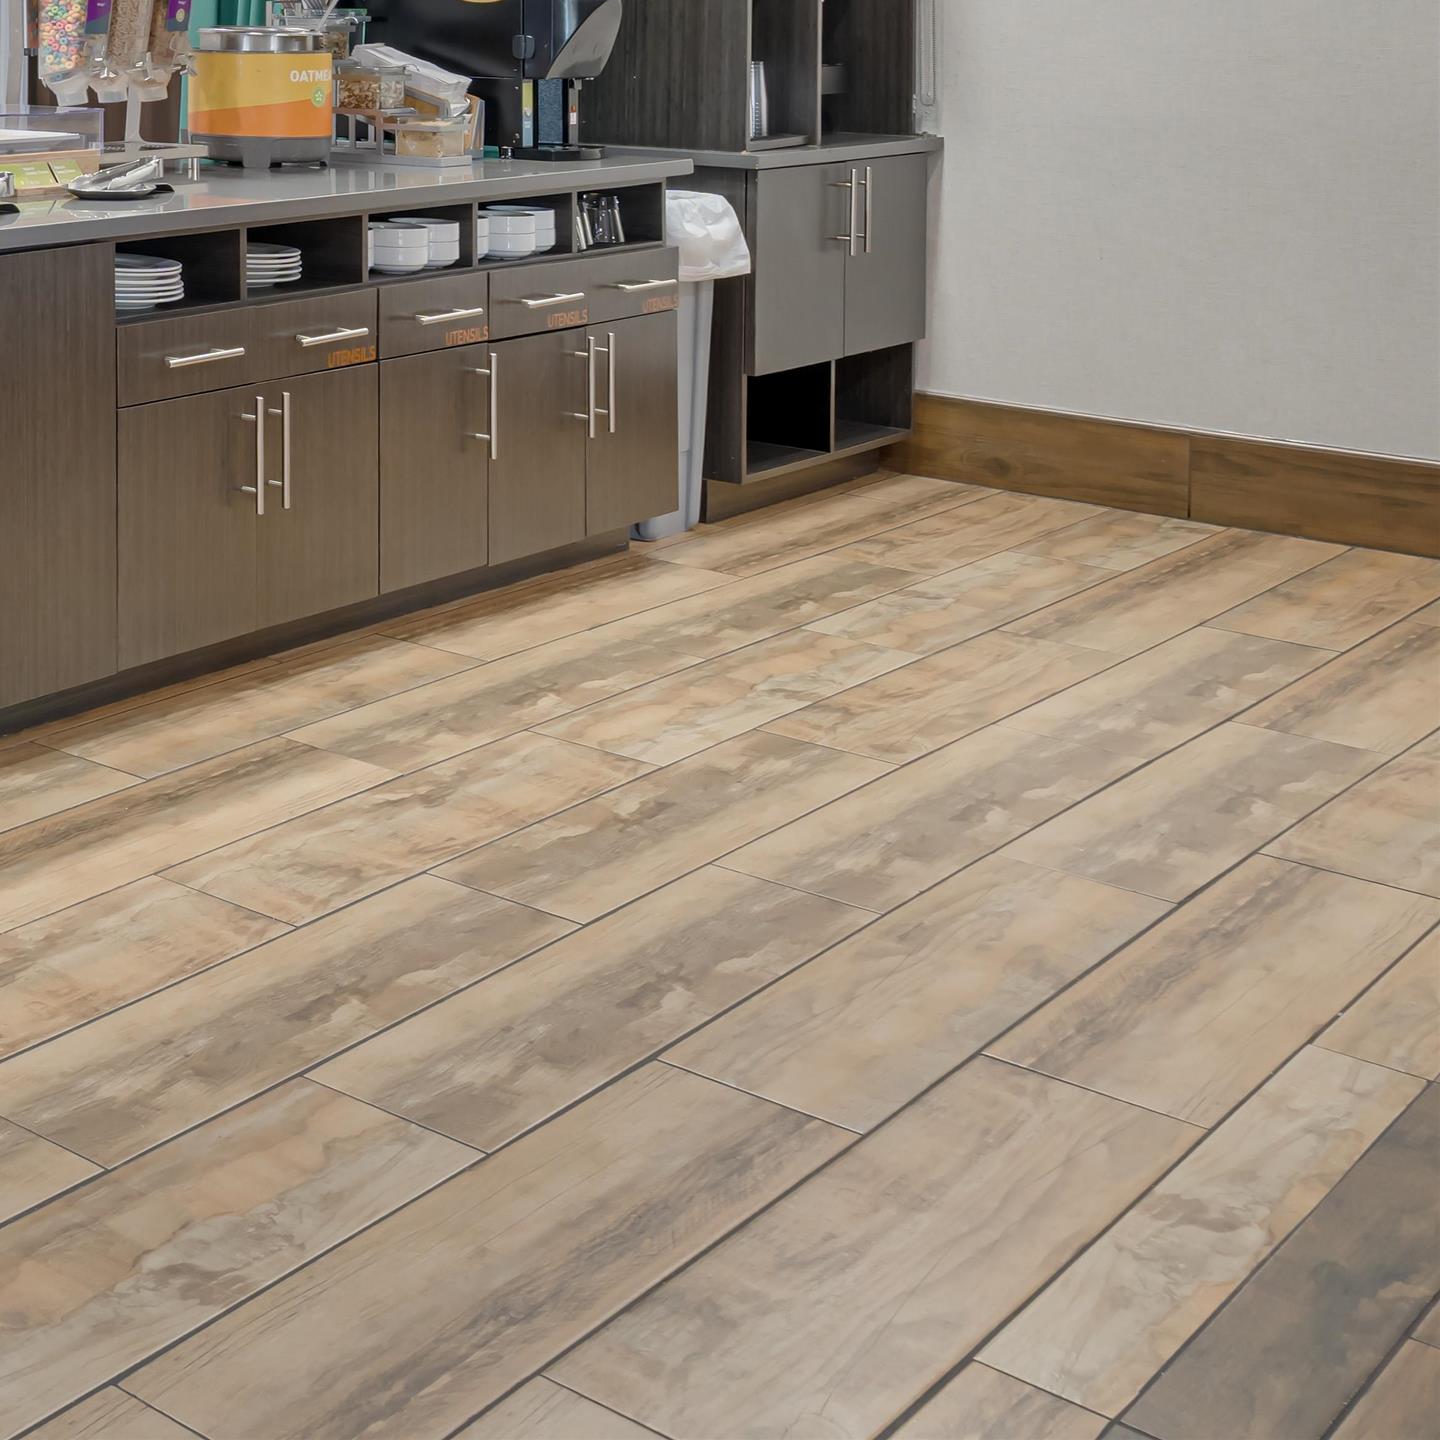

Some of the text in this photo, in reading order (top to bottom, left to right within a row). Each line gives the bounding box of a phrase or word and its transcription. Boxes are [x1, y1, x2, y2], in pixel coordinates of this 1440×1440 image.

[642, 295, 680, 314] UTENSILS
[547, 308, 589, 328] UTENSILS
[445, 324, 489, 346] UTENSILS
[327, 345, 376, 368] UTENSILS
